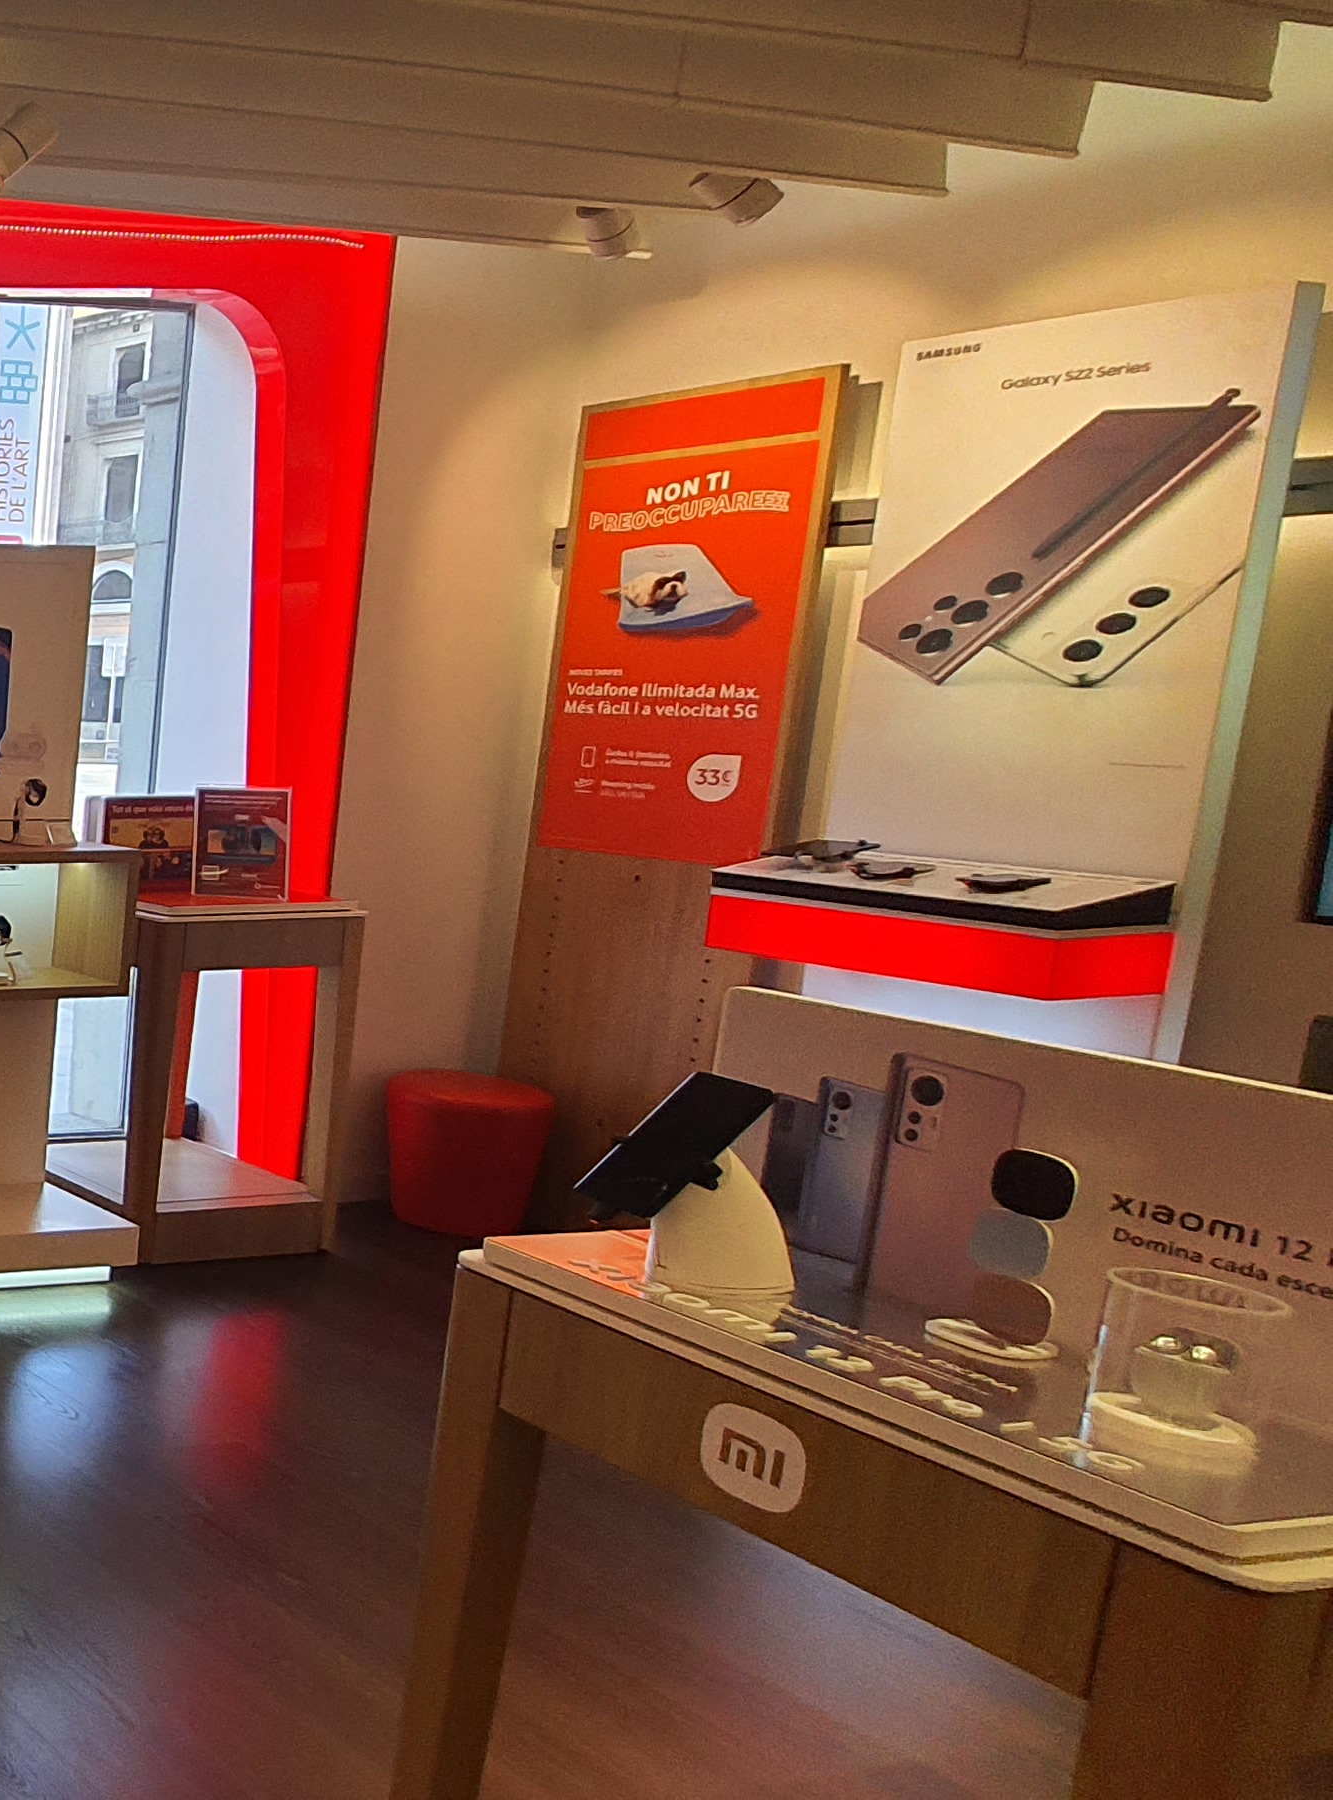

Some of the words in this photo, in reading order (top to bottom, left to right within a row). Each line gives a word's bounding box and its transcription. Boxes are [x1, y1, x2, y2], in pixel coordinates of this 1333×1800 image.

[916, 342, 982, 361] SAMSUNG
[1001, 373, 1061, 391] Galaxy
[1064, 366, 1094, 383] S22
[1096, 361, 1151, 379] Series
[11, 438, 30, 490] L'ART
[646, 477, 700, 505] NON
[706, 470, 730, 490] TI
[8, 498, 26, 523] DE
[567, 682, 638, 697] Vodafone
[719, 684, 760, 699] Max.
[564, 700, 594, 714] Més
[598, 700, 630, 715] fàcil
[642, 705, 651, 715] a
[655, 703, 729, 718] velocitat
[733, 704, 759, 719] 5G
[1112, 1225, 1203, 1265] Domina
[1209, 1255, 1269, 1282] cada
[1276, 1274, 1333, 1300] esce
[1277, 1236, 1313, 1263] 12
